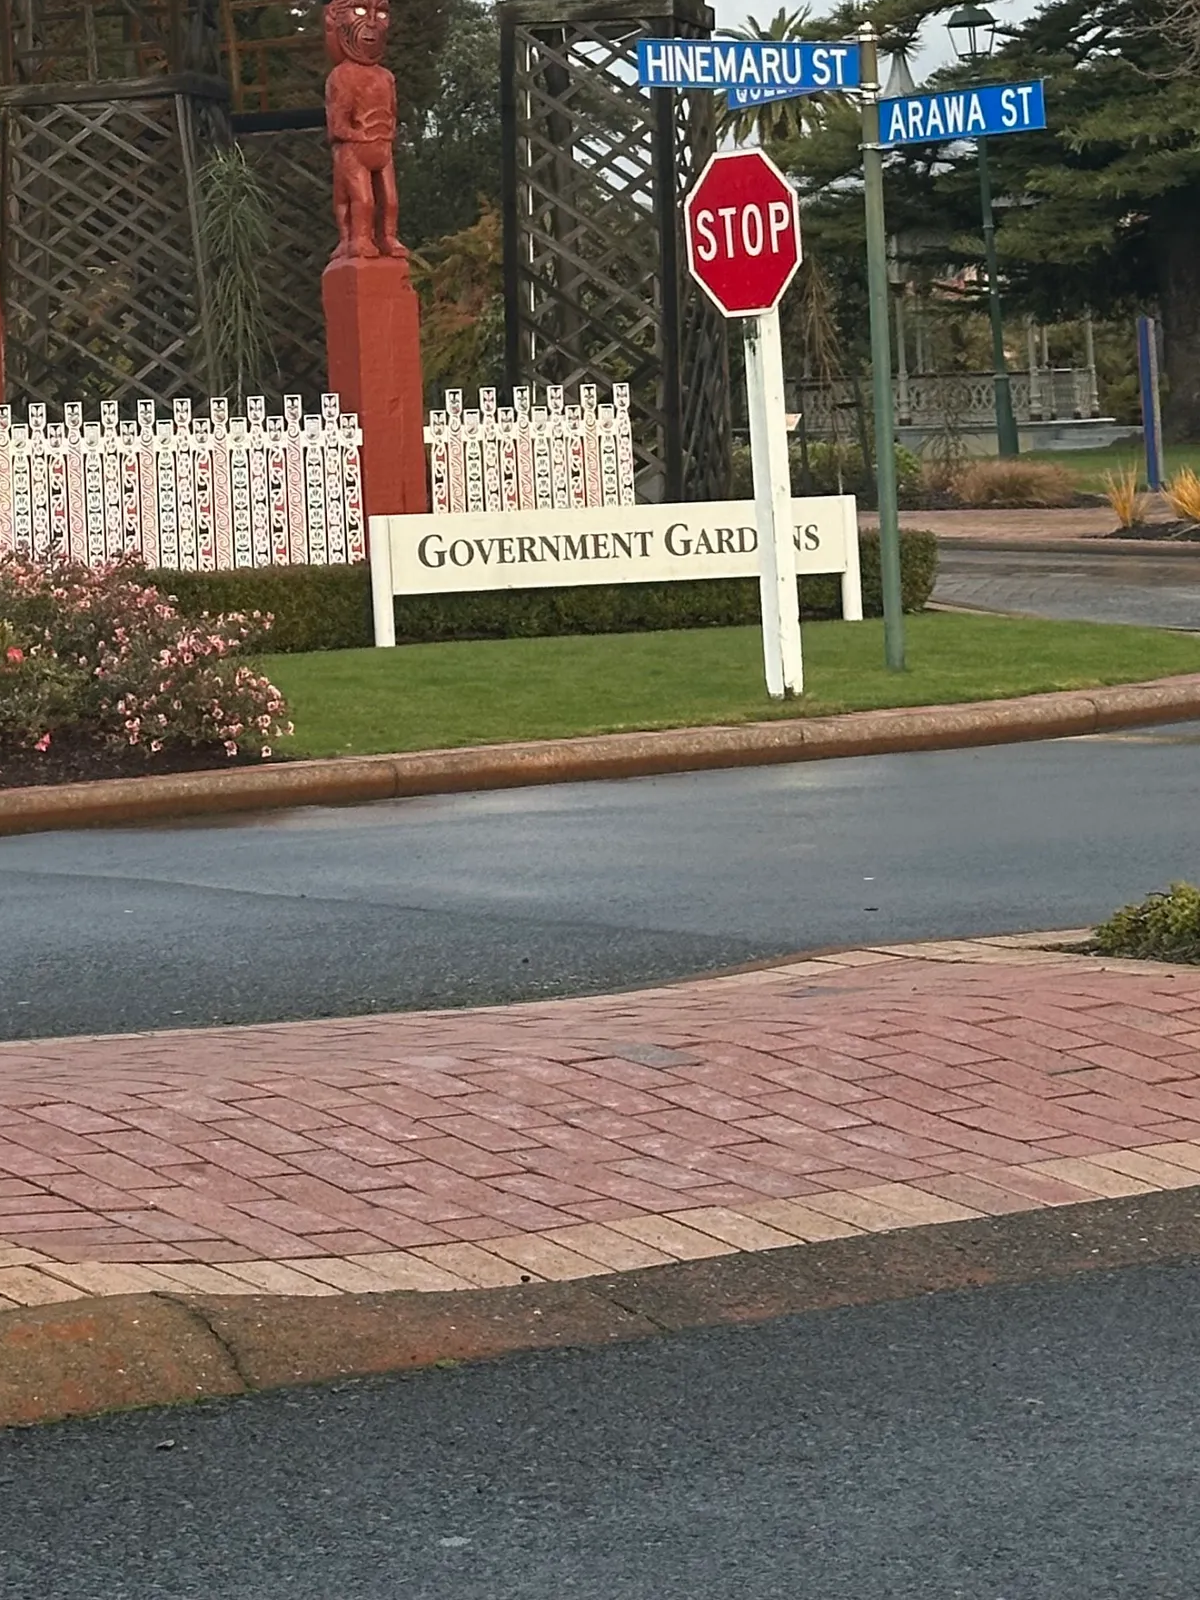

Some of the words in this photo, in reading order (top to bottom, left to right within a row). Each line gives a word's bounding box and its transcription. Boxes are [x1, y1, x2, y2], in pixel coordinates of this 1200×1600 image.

[646, 45, 802, 85] HINEMARU
[812, 48, 848, 85] ST
[888, 93, 987, 141] ARAWA
[1001, 86, 1033, 128] ST
[696, 201, 790, 262] STOP
[417, 530, 654, 568] GOVERNMENT
[664, 523, 820, 557] GARDS
